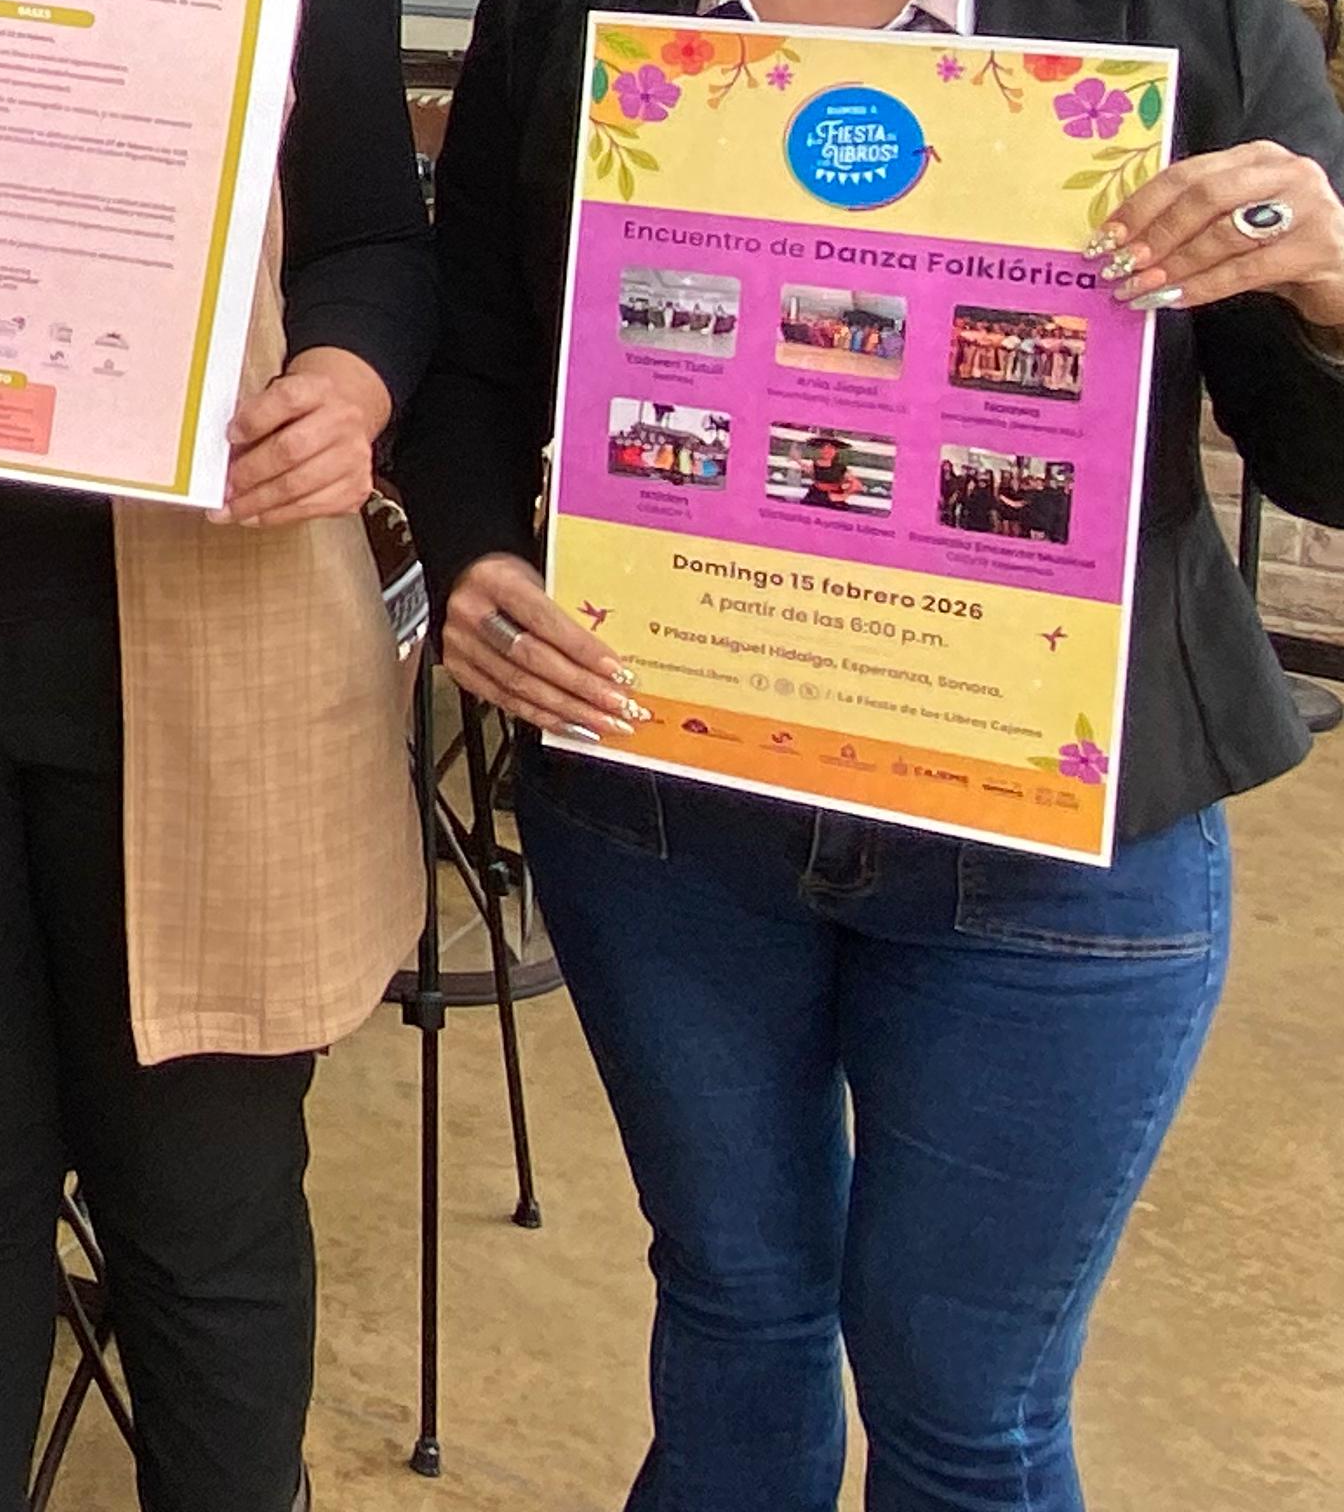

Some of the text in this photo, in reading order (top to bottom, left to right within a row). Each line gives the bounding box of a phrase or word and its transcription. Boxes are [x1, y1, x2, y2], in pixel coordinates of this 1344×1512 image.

[815, 119, 886, 147] FIESTA
[820, 143, 900, 171] LIBROS!
[623, 220, 1098, 290] Encuentro de Danza Folklórica
[672, 553, 985, 621] Domingo 15 febrero 2026
[699, 591, 950, 649] A partir de las 6:00 p.m.
[663, 624, 1005, 699] Plaza Miguel Hidalgo, Esperanza, Sonora.
